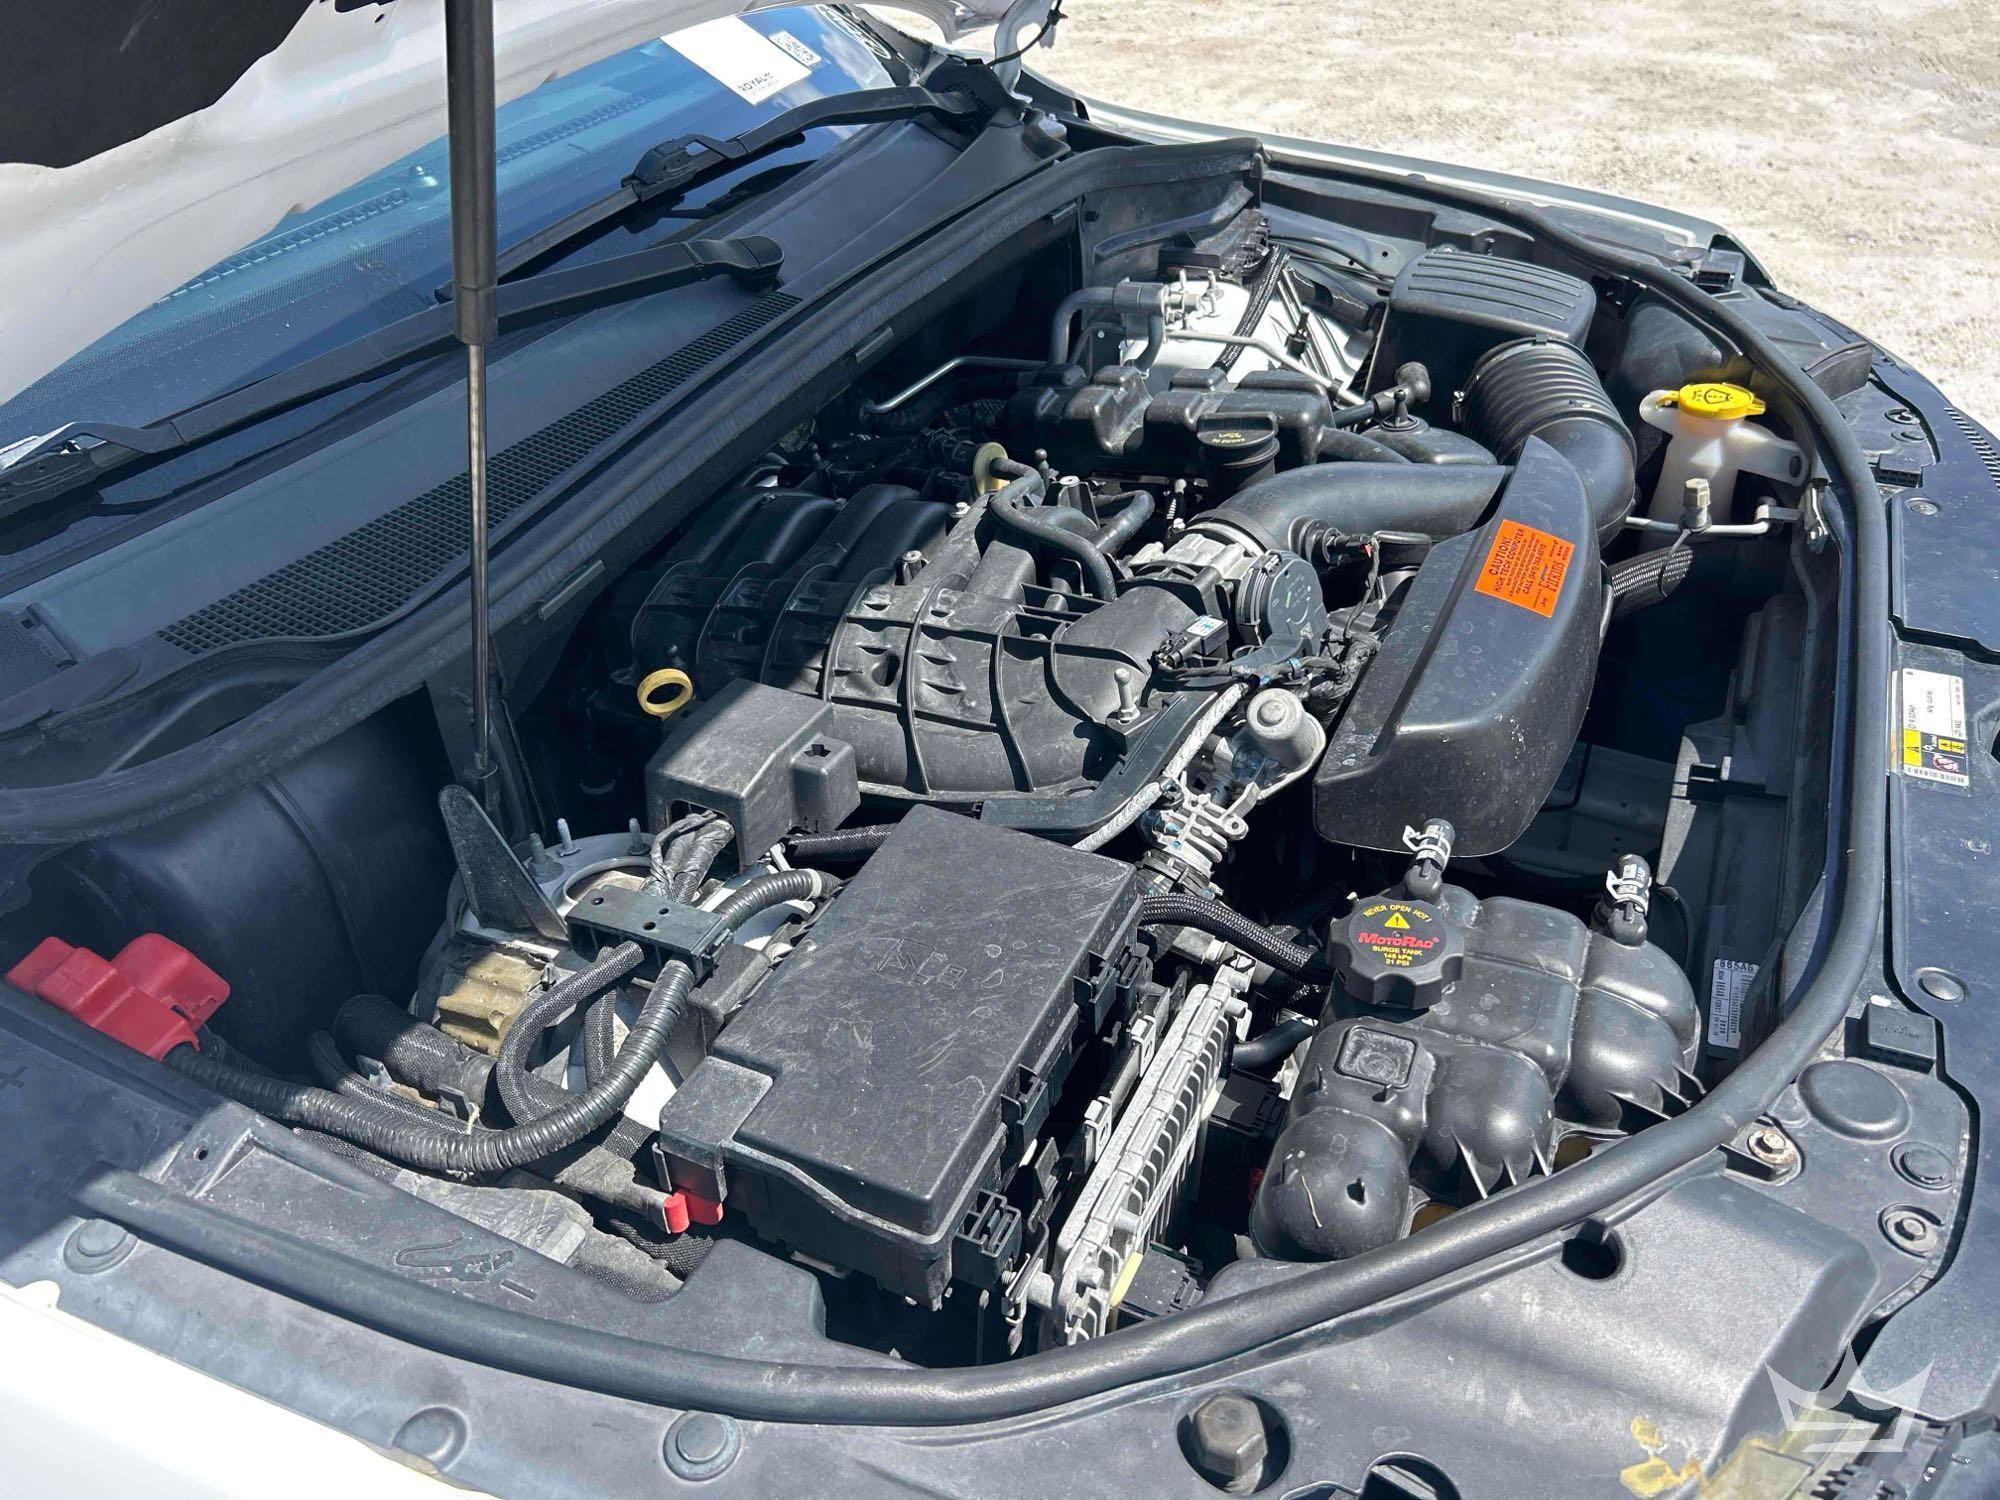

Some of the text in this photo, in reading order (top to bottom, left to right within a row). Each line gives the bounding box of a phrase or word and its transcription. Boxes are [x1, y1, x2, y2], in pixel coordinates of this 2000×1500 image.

[1489, 537, 1511, 576] CAUTION!
[1493, 576, 1505, 592] HIGH
[1499, 559, 1512, 576] TECH
[1507, 529, 1525, 560] COMPUTER
[1522, 579, 1534, 594] CALL
[1363, 904, 1432, 922] NEVER OPEN HOT!
[1372, 945, 1423, 956] SURGE TANK
